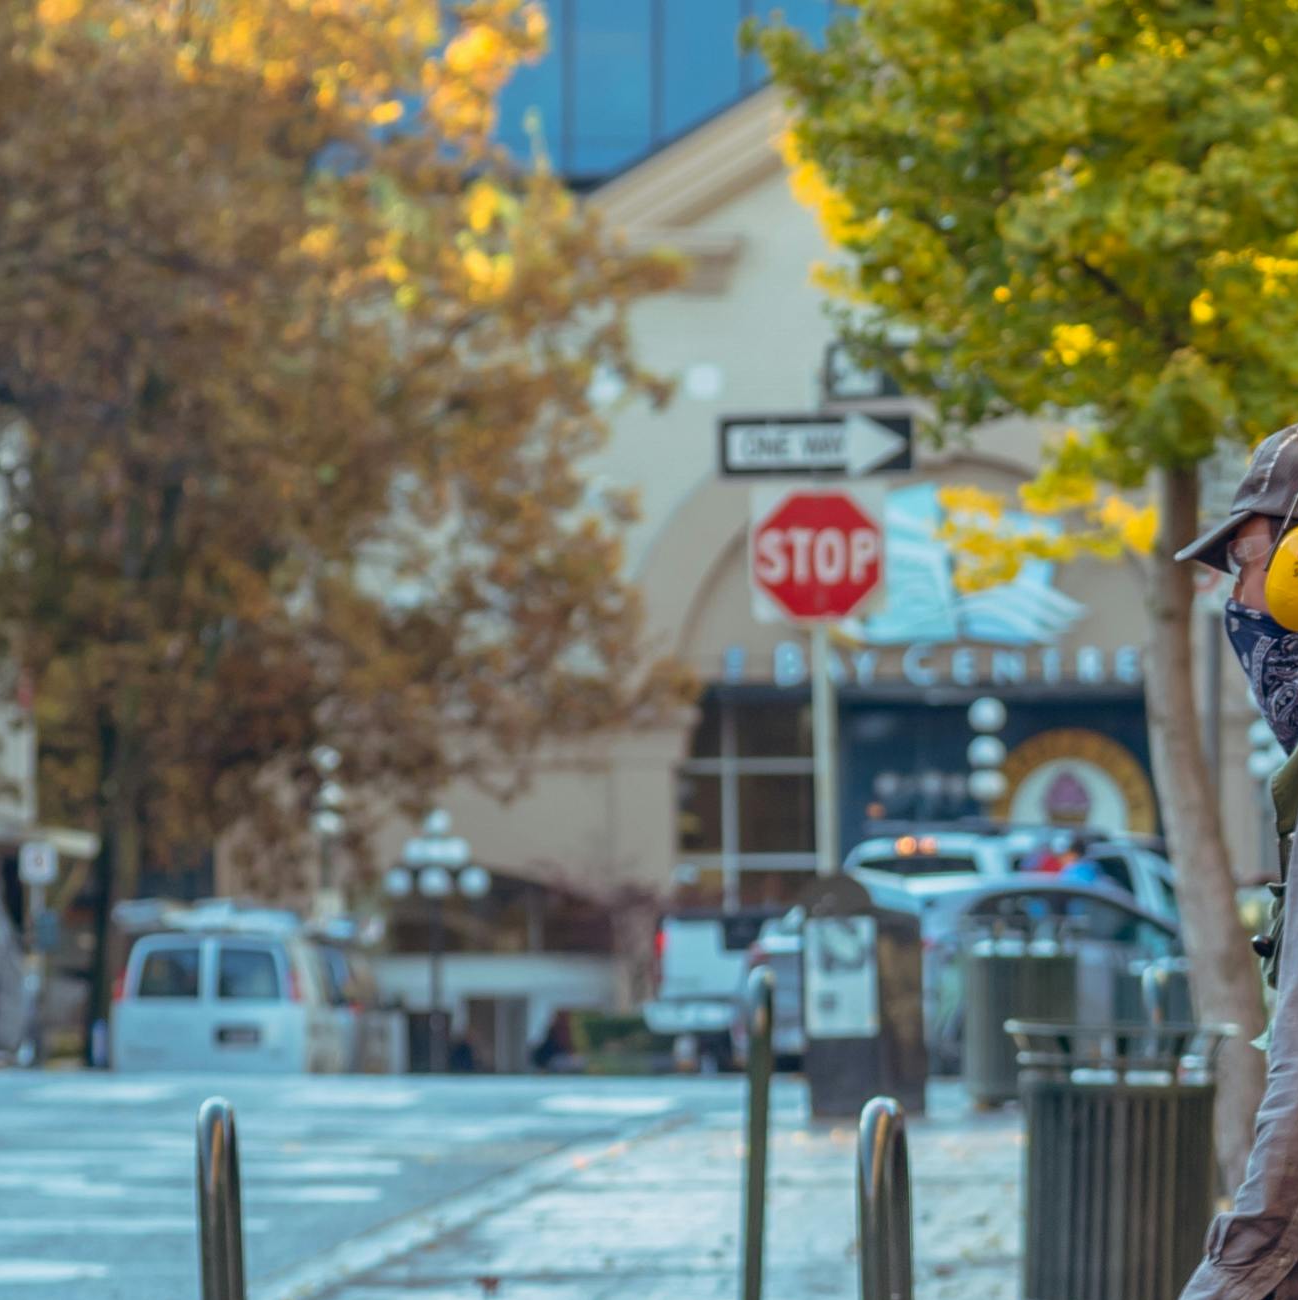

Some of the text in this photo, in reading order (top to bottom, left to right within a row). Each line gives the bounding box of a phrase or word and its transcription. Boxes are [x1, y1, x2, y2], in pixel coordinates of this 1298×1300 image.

[742, 433, 843, 456] ONE WAY
[756, 526, 879, 585] STOP
[902, 643, 1141, 687] CENTRE
